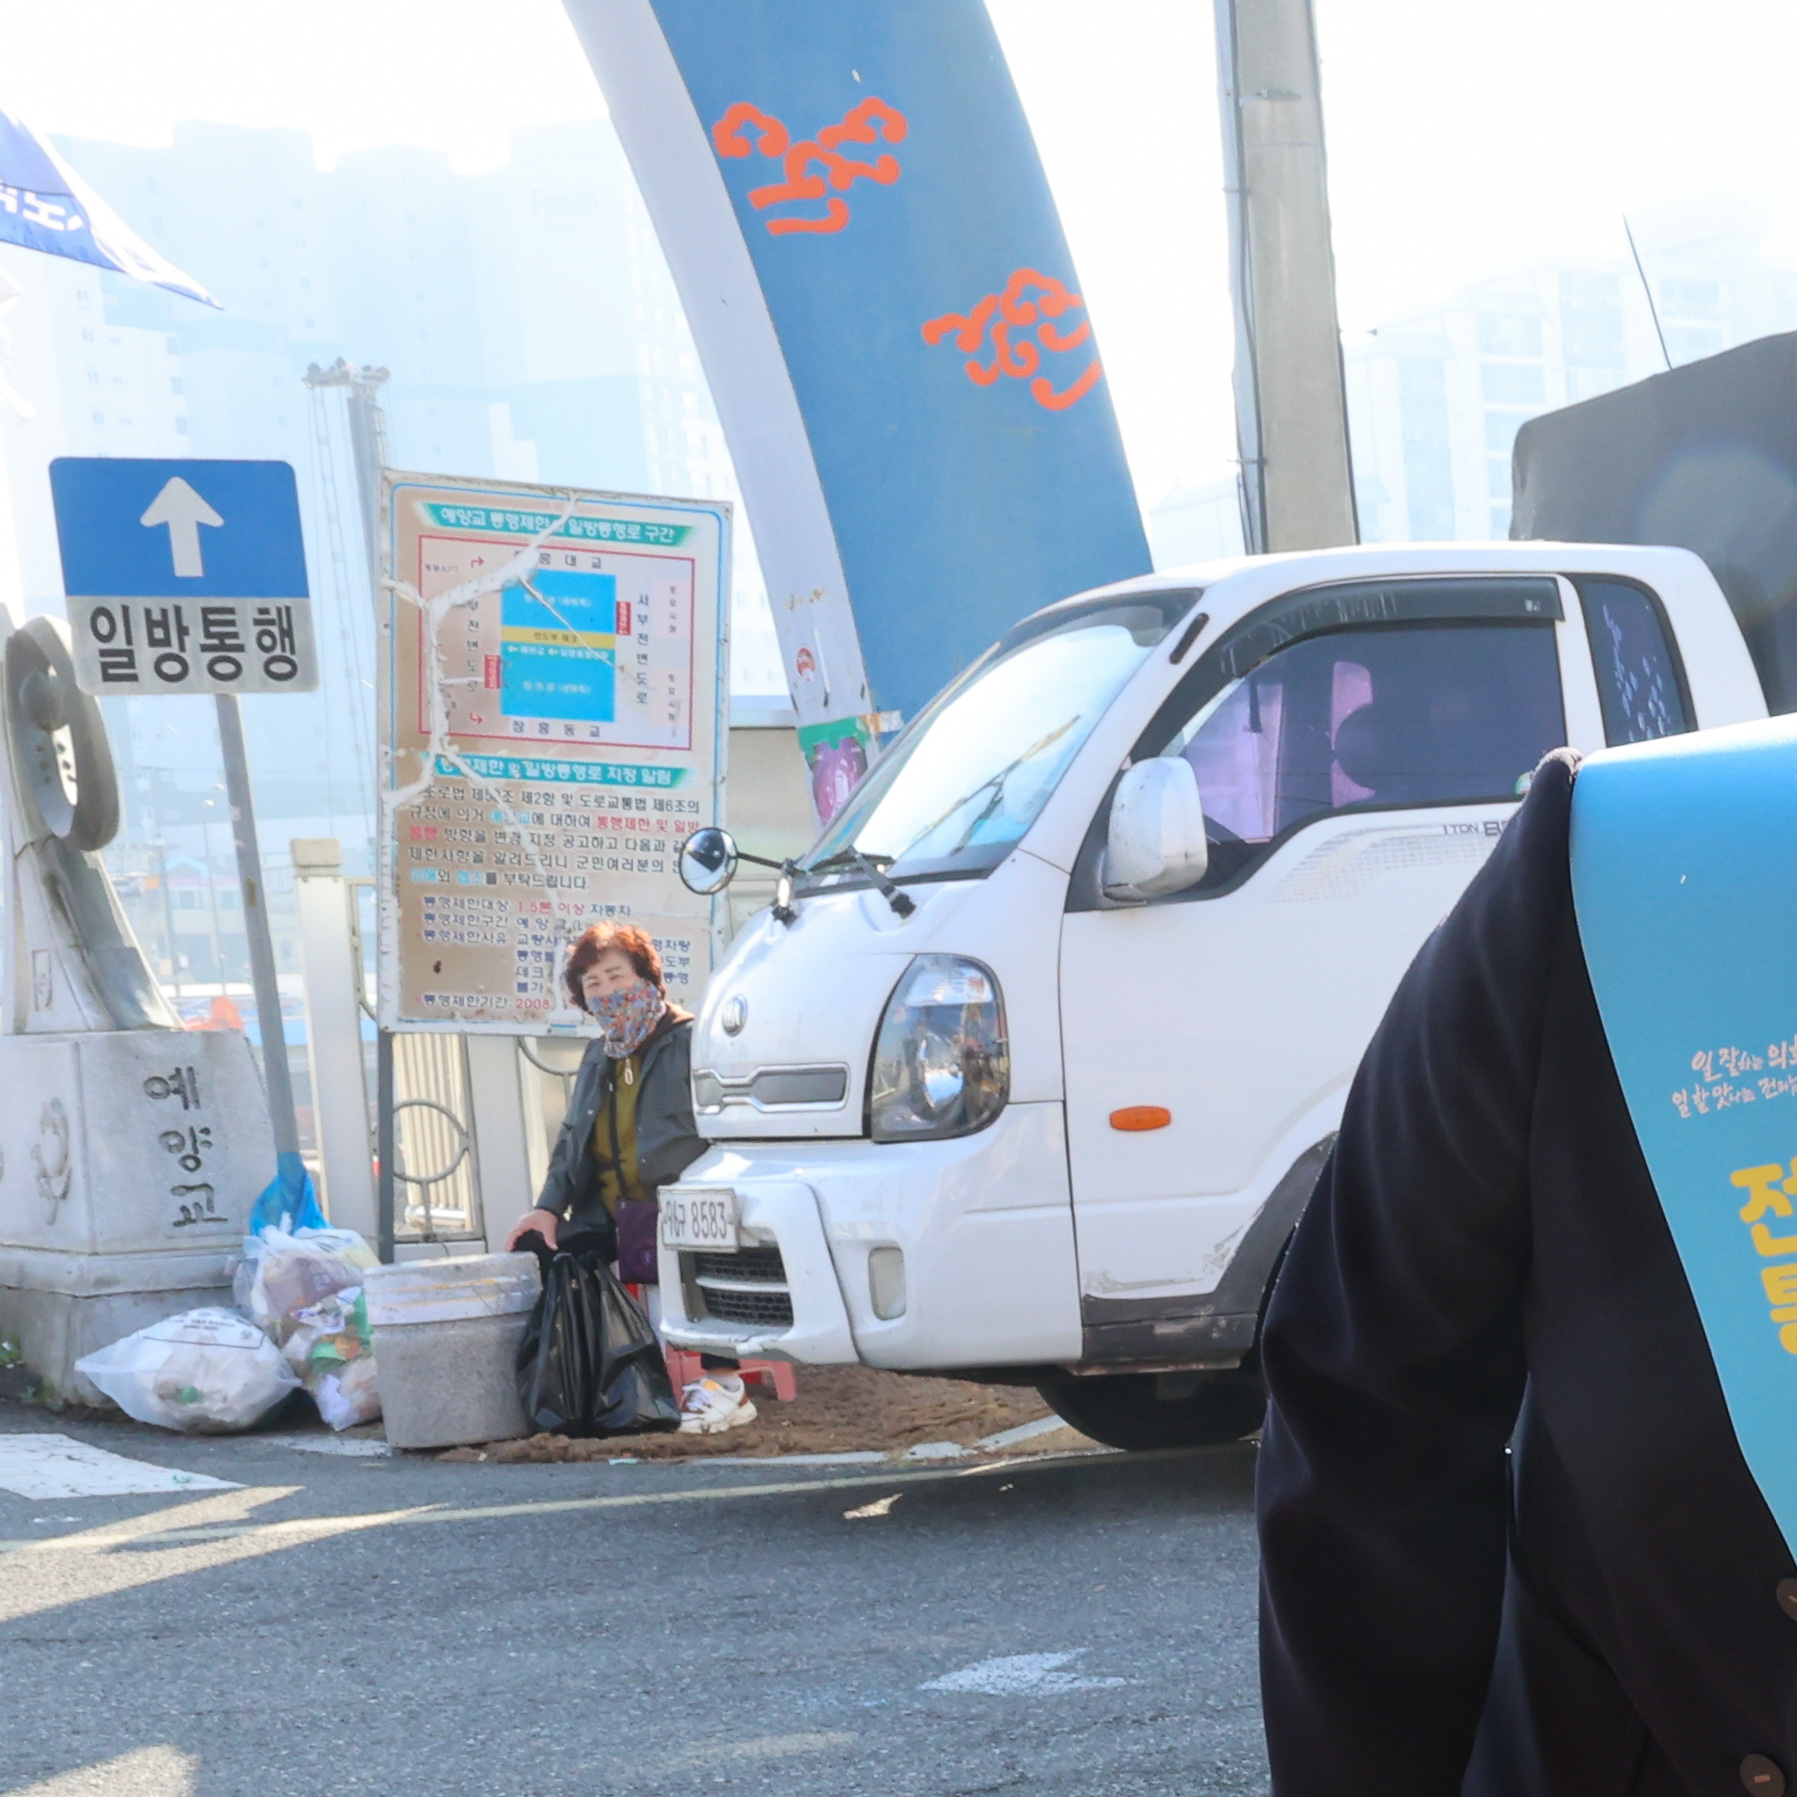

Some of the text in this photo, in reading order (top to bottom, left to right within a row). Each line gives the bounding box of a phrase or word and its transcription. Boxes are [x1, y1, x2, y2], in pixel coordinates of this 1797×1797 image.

[644, 525, 676, 543] 구간
[88, 602, 300, 687] 일방통행
[606, 766, 638, 784] 지정
[640, 768, 672, 786] 알림
[1450, 822, 1480, 835] TON
[1690, 1049, 1723, 1083] 일
[1718, 1045, 1765, 1078] 잘하는
[1671, 1087, 1692, 1119] 일
[1691, 1082, 1710, 1115] 할
[141, 1066, 228, 1231] 예양교
[690, 1199, 727, 1240] 8583
